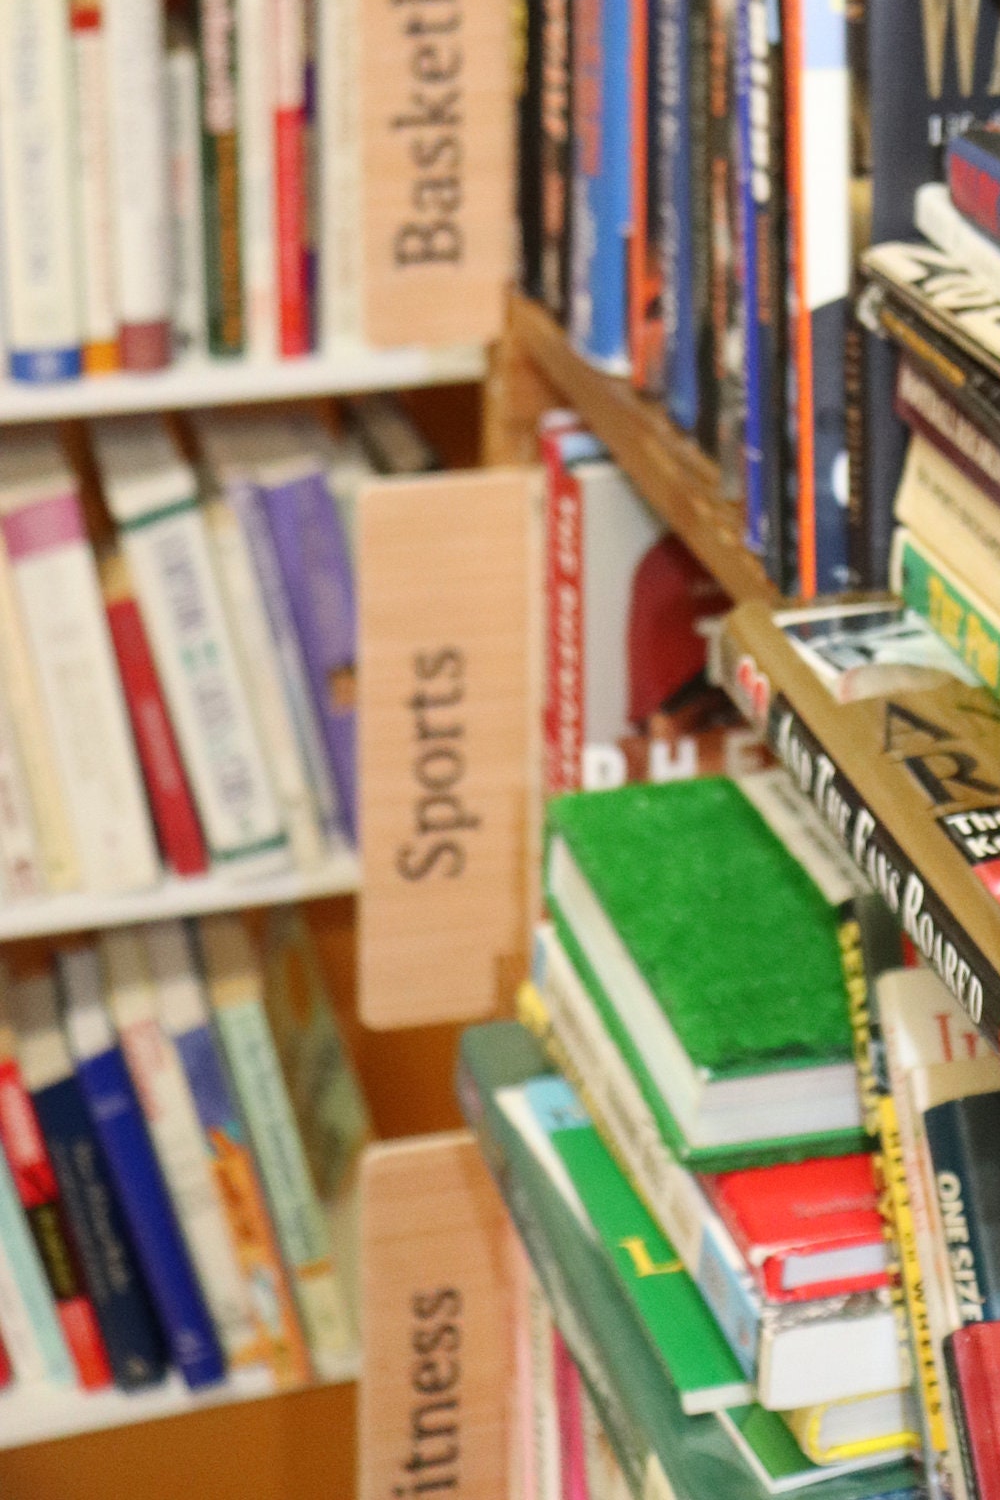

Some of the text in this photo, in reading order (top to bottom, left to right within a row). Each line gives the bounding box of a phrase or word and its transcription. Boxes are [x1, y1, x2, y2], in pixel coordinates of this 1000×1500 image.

[395, 647, 481, 884] Sports
[903, 871, 984, 1025] ROARED
[938, 1170, 971, 1245] ONE
